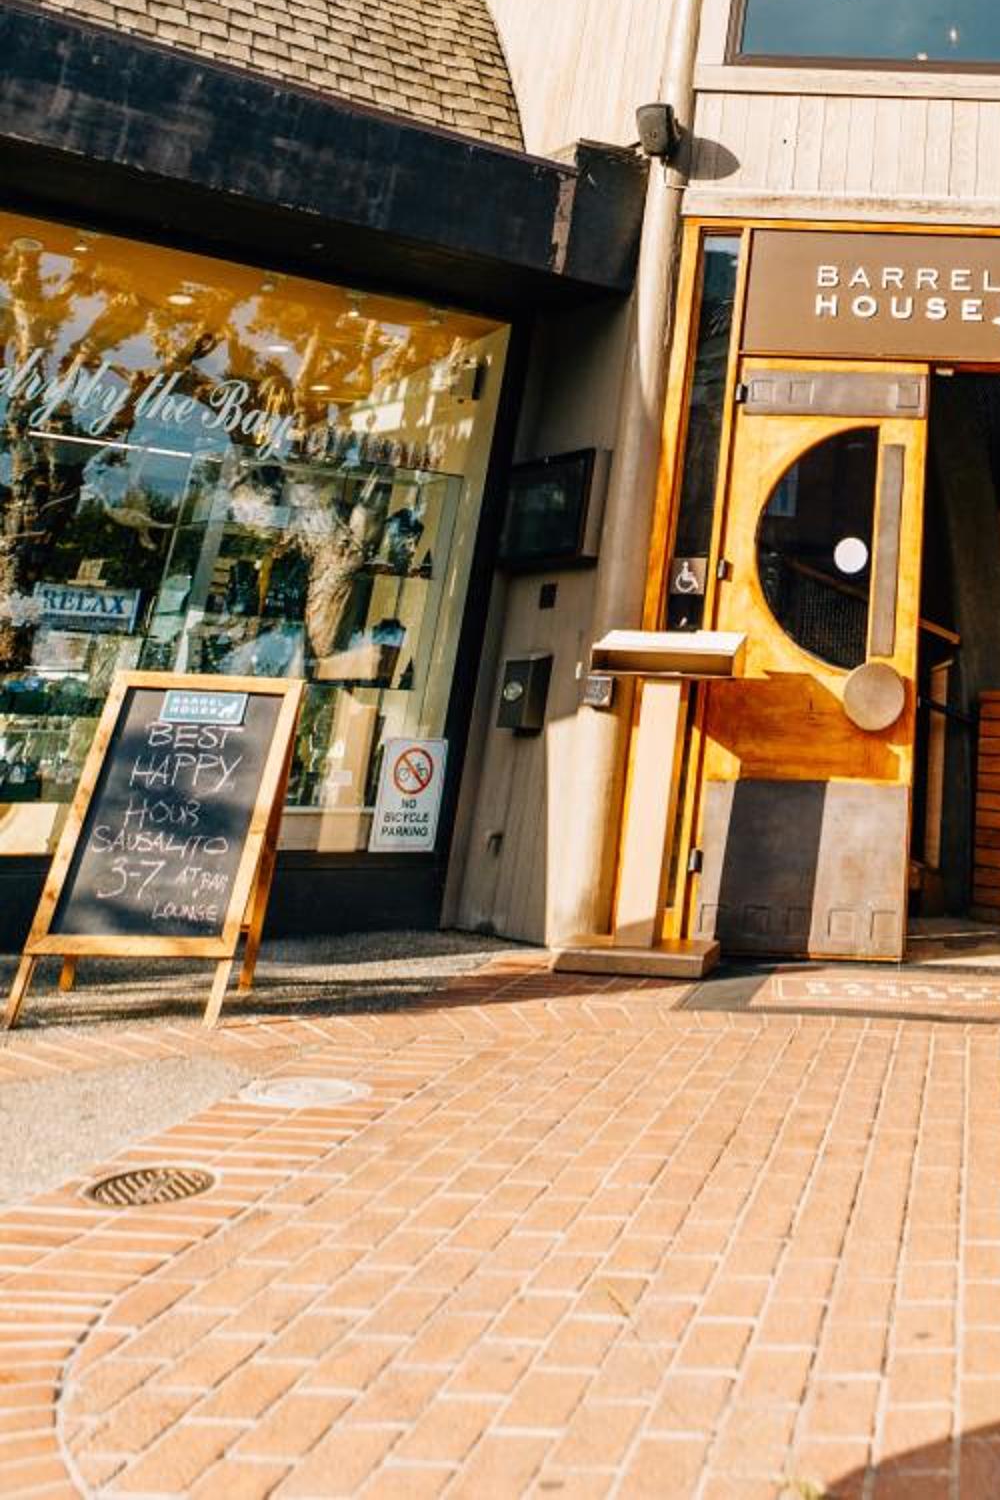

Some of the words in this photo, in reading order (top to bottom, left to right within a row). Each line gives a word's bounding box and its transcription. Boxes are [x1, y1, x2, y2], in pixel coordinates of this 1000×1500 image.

[814, 294, 985, 322] HOUSE
[76, 359, 132, 436] by
[134, 371, 194, 424] the
[201, 379, 294, 461] Bay
[42, 589, 125, 614] RELAX
[145, 722, 244, 749] BEST
[129, 753, 243, 793] HAPPY
[124, 799, 201, 829] HOUR
[383, 811, 429, 823] BICYCLE
[401, 799, 417, 809] NO
[92, 825, 229, 857] SAUSALITO
[381, 826, 429, 836] PARKING
[96, 856, 166, 900] 3-7
[151, 901, 218, 922] LOUNGE
